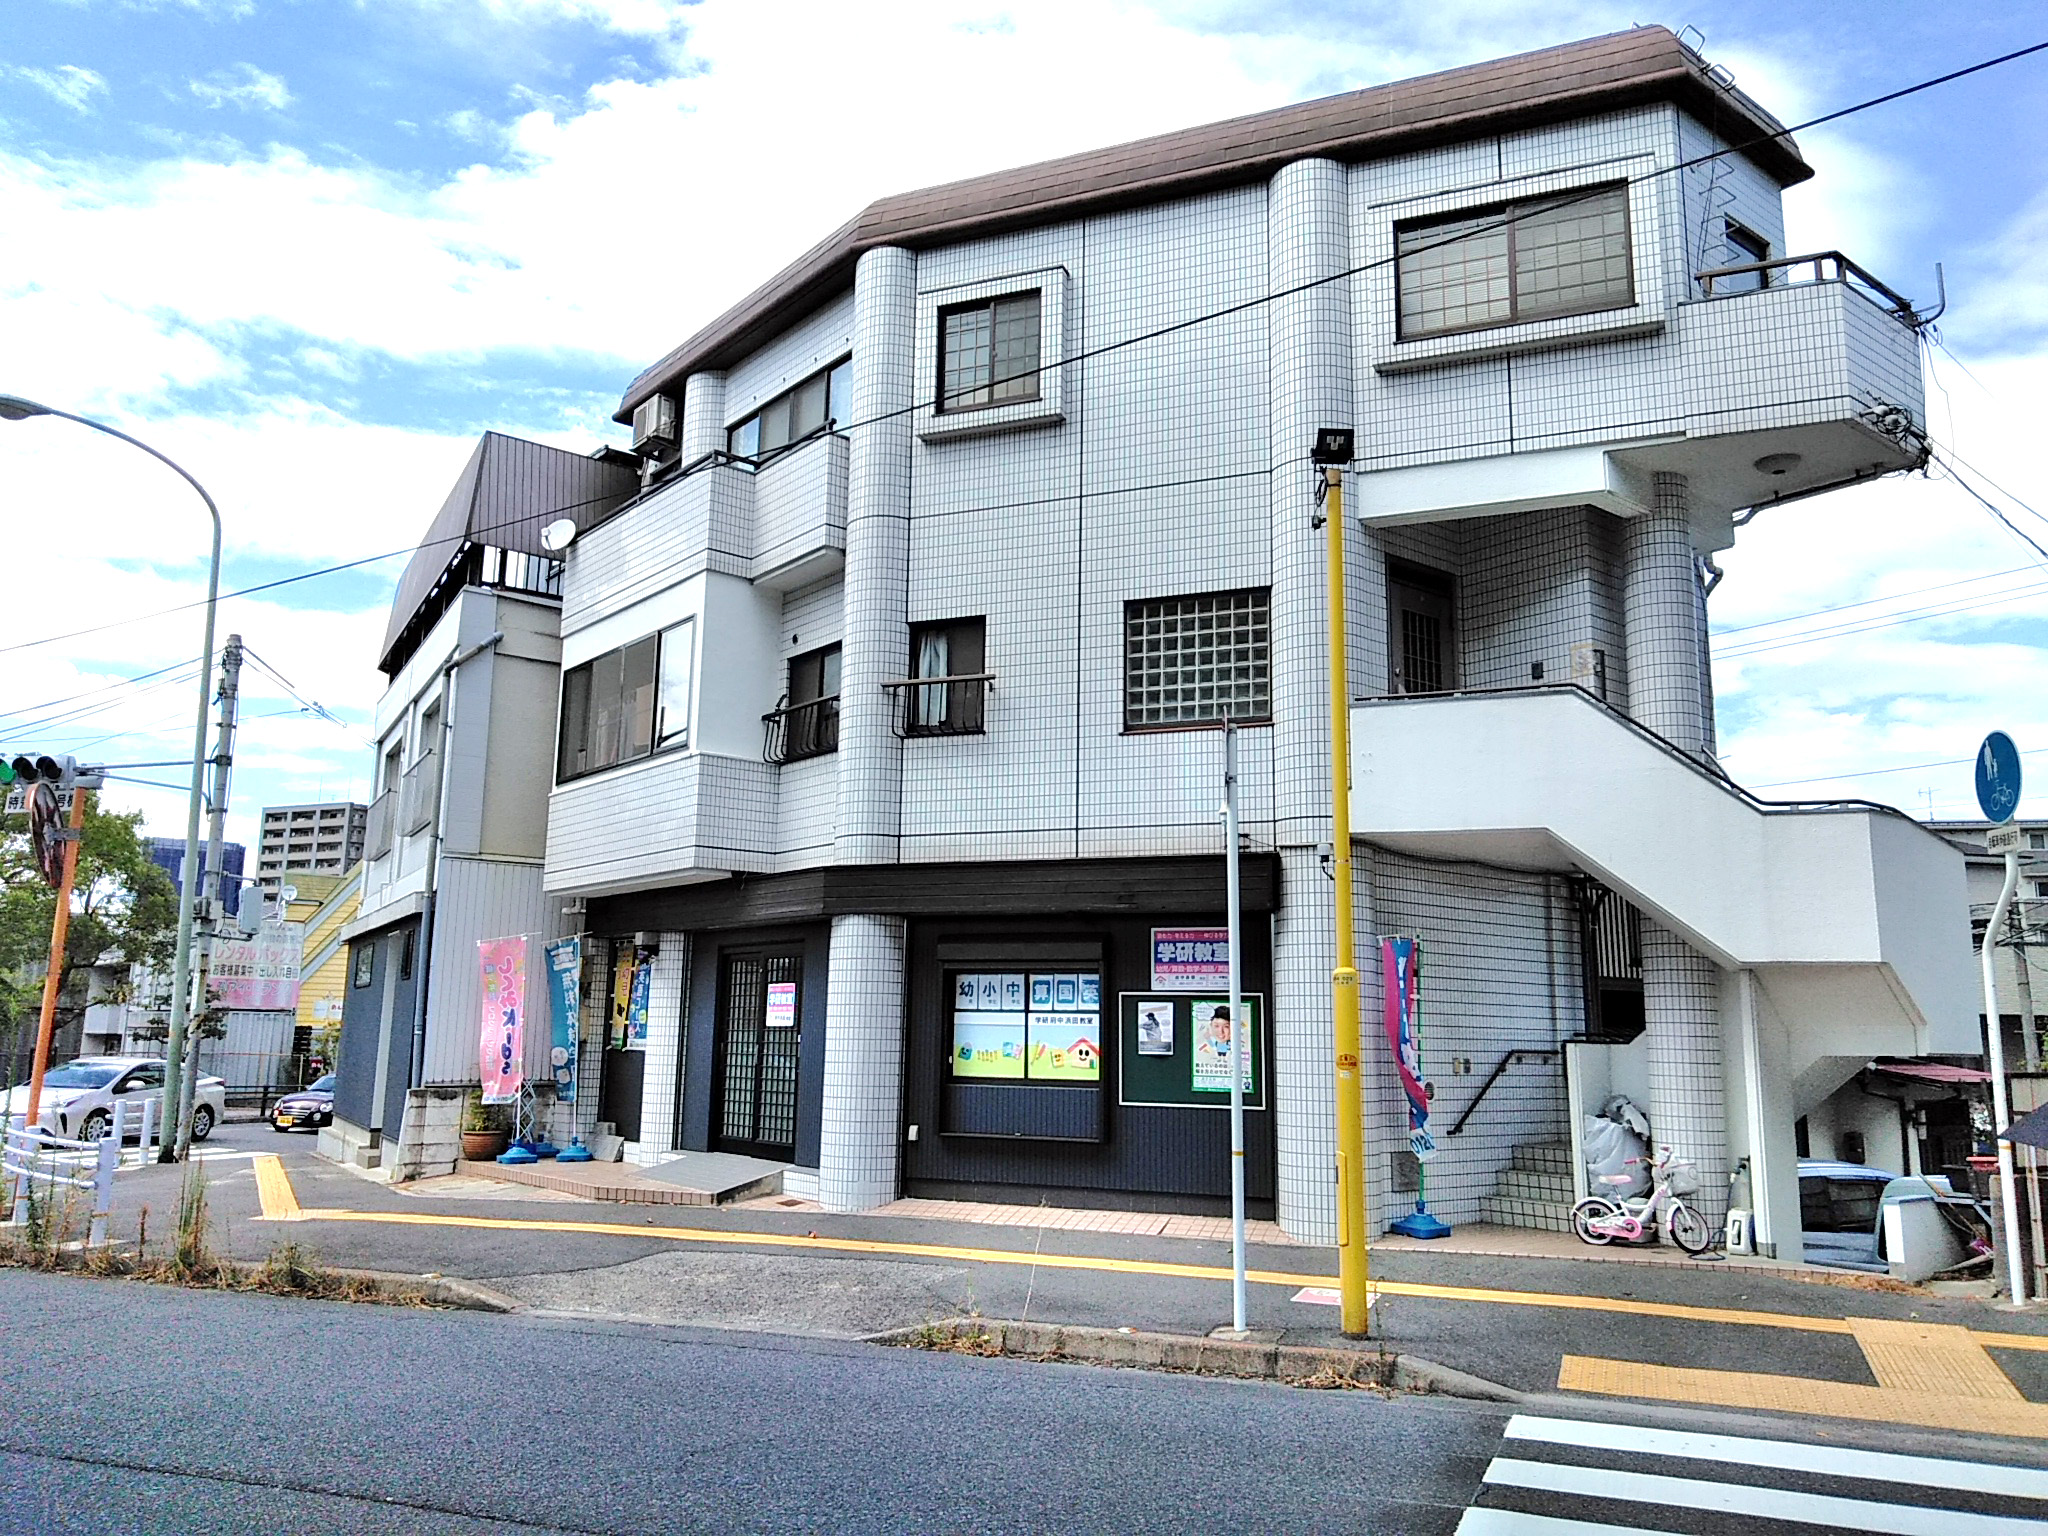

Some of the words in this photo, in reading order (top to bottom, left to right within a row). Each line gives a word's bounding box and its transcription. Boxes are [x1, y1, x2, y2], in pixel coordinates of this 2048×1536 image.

[1157, 942, 1229, 962] 学研教室
[959, 981, 974, 997] 幼
[982, 981, 996, 997] 小
[1006, 981, 1020, 997] 中
